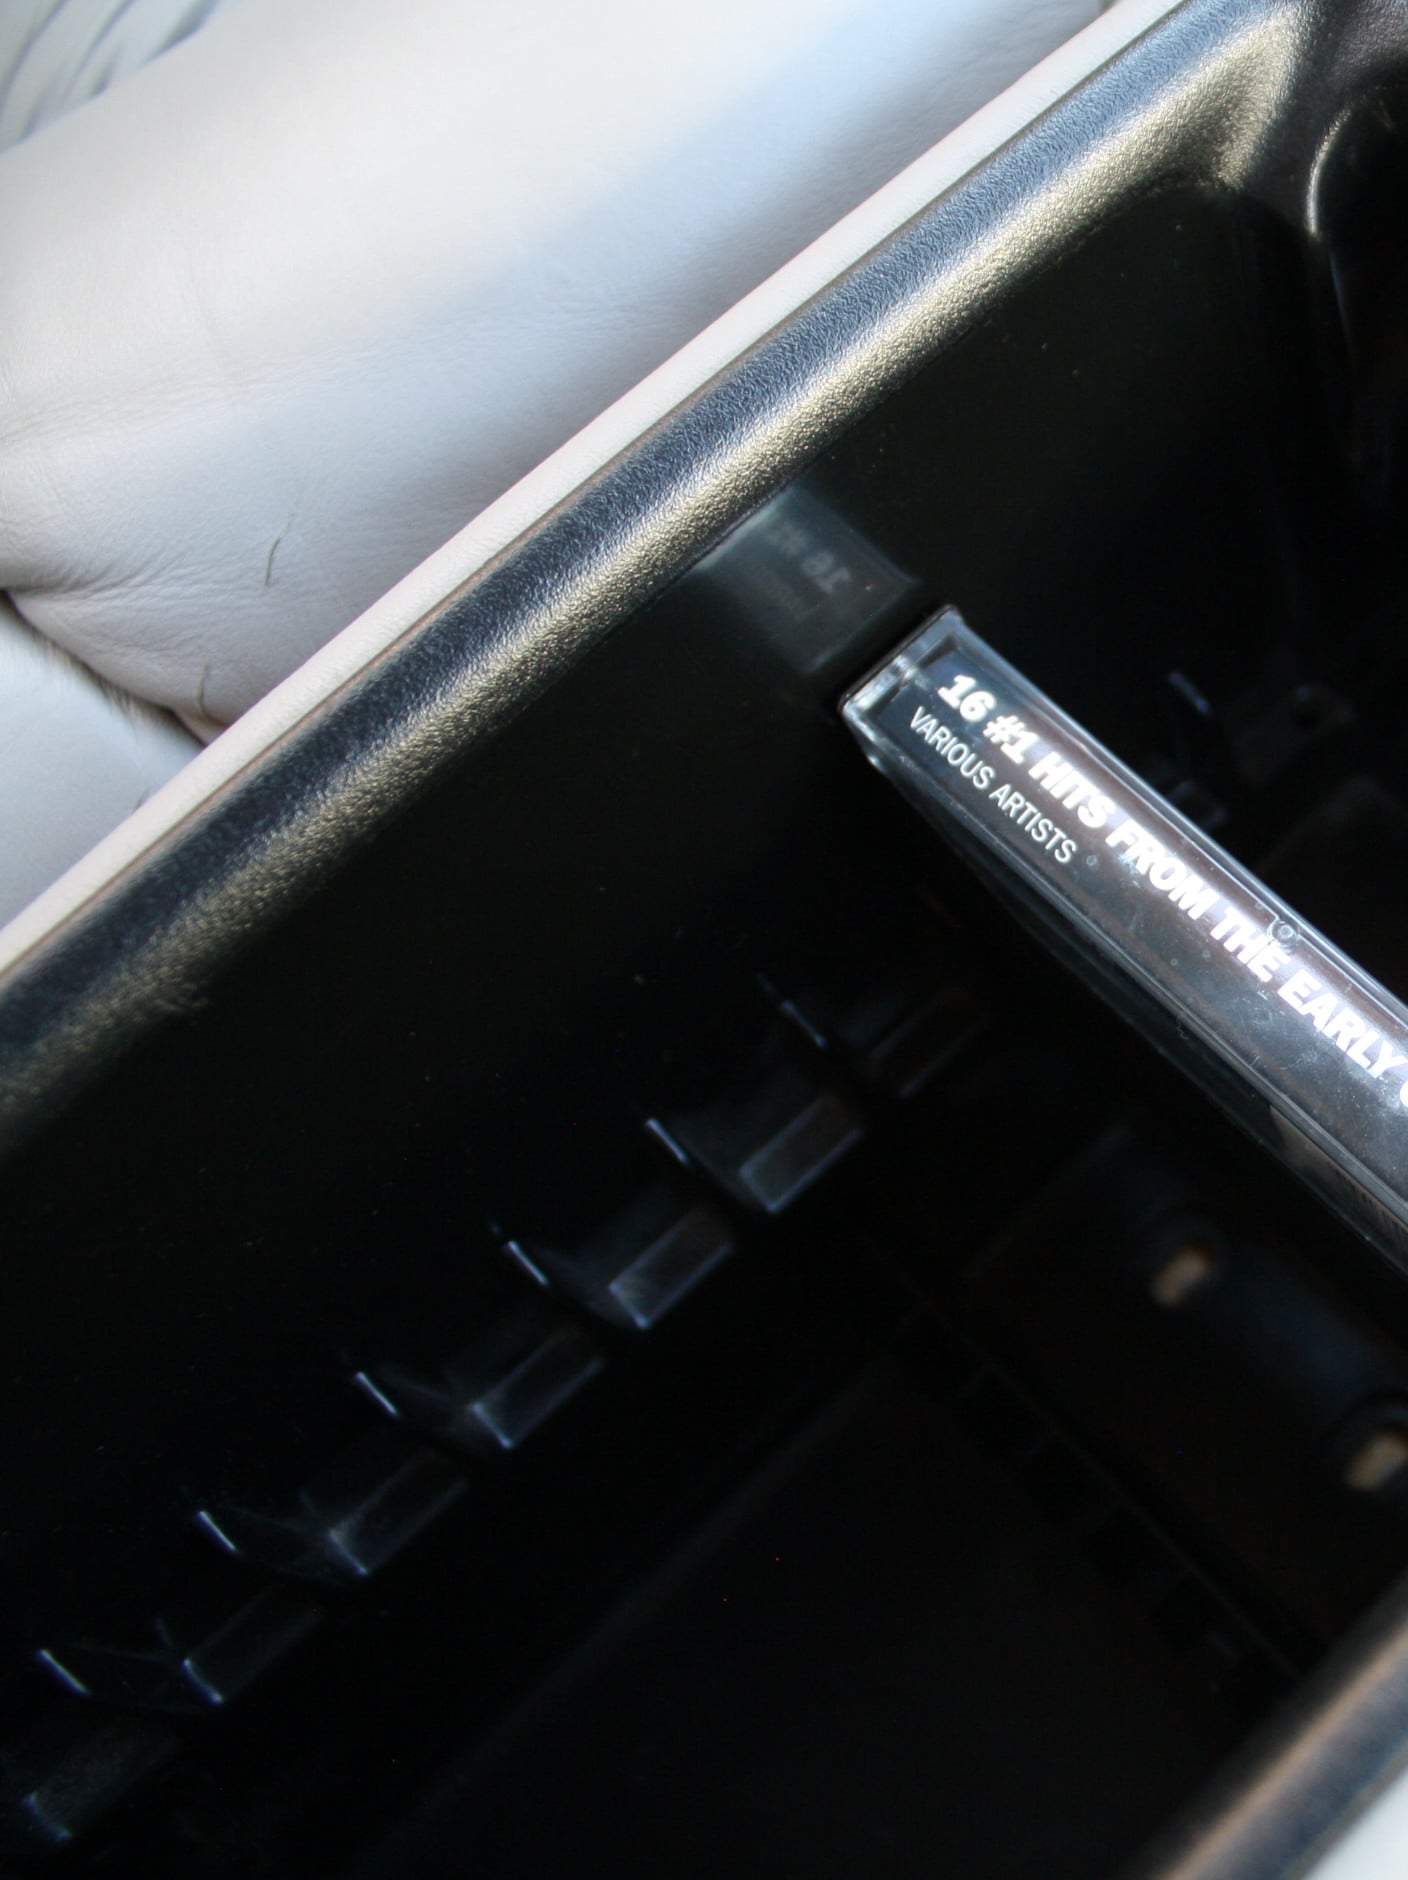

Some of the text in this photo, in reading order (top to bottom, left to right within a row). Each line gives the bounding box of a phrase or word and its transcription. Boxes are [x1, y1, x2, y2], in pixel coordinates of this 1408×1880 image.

[909, 706, 1077, 863] VARIOUS ARTISTS
[937, 673, 998, 723] 16
[983, 714, 1038, 764] #1
[1028, 751, 1116, 829] HITS
[1105, 819, 1219, 922] FROM
[1210, 905, 1291, 983] THE
[1277, 968, 1408, 1079] EARLY
